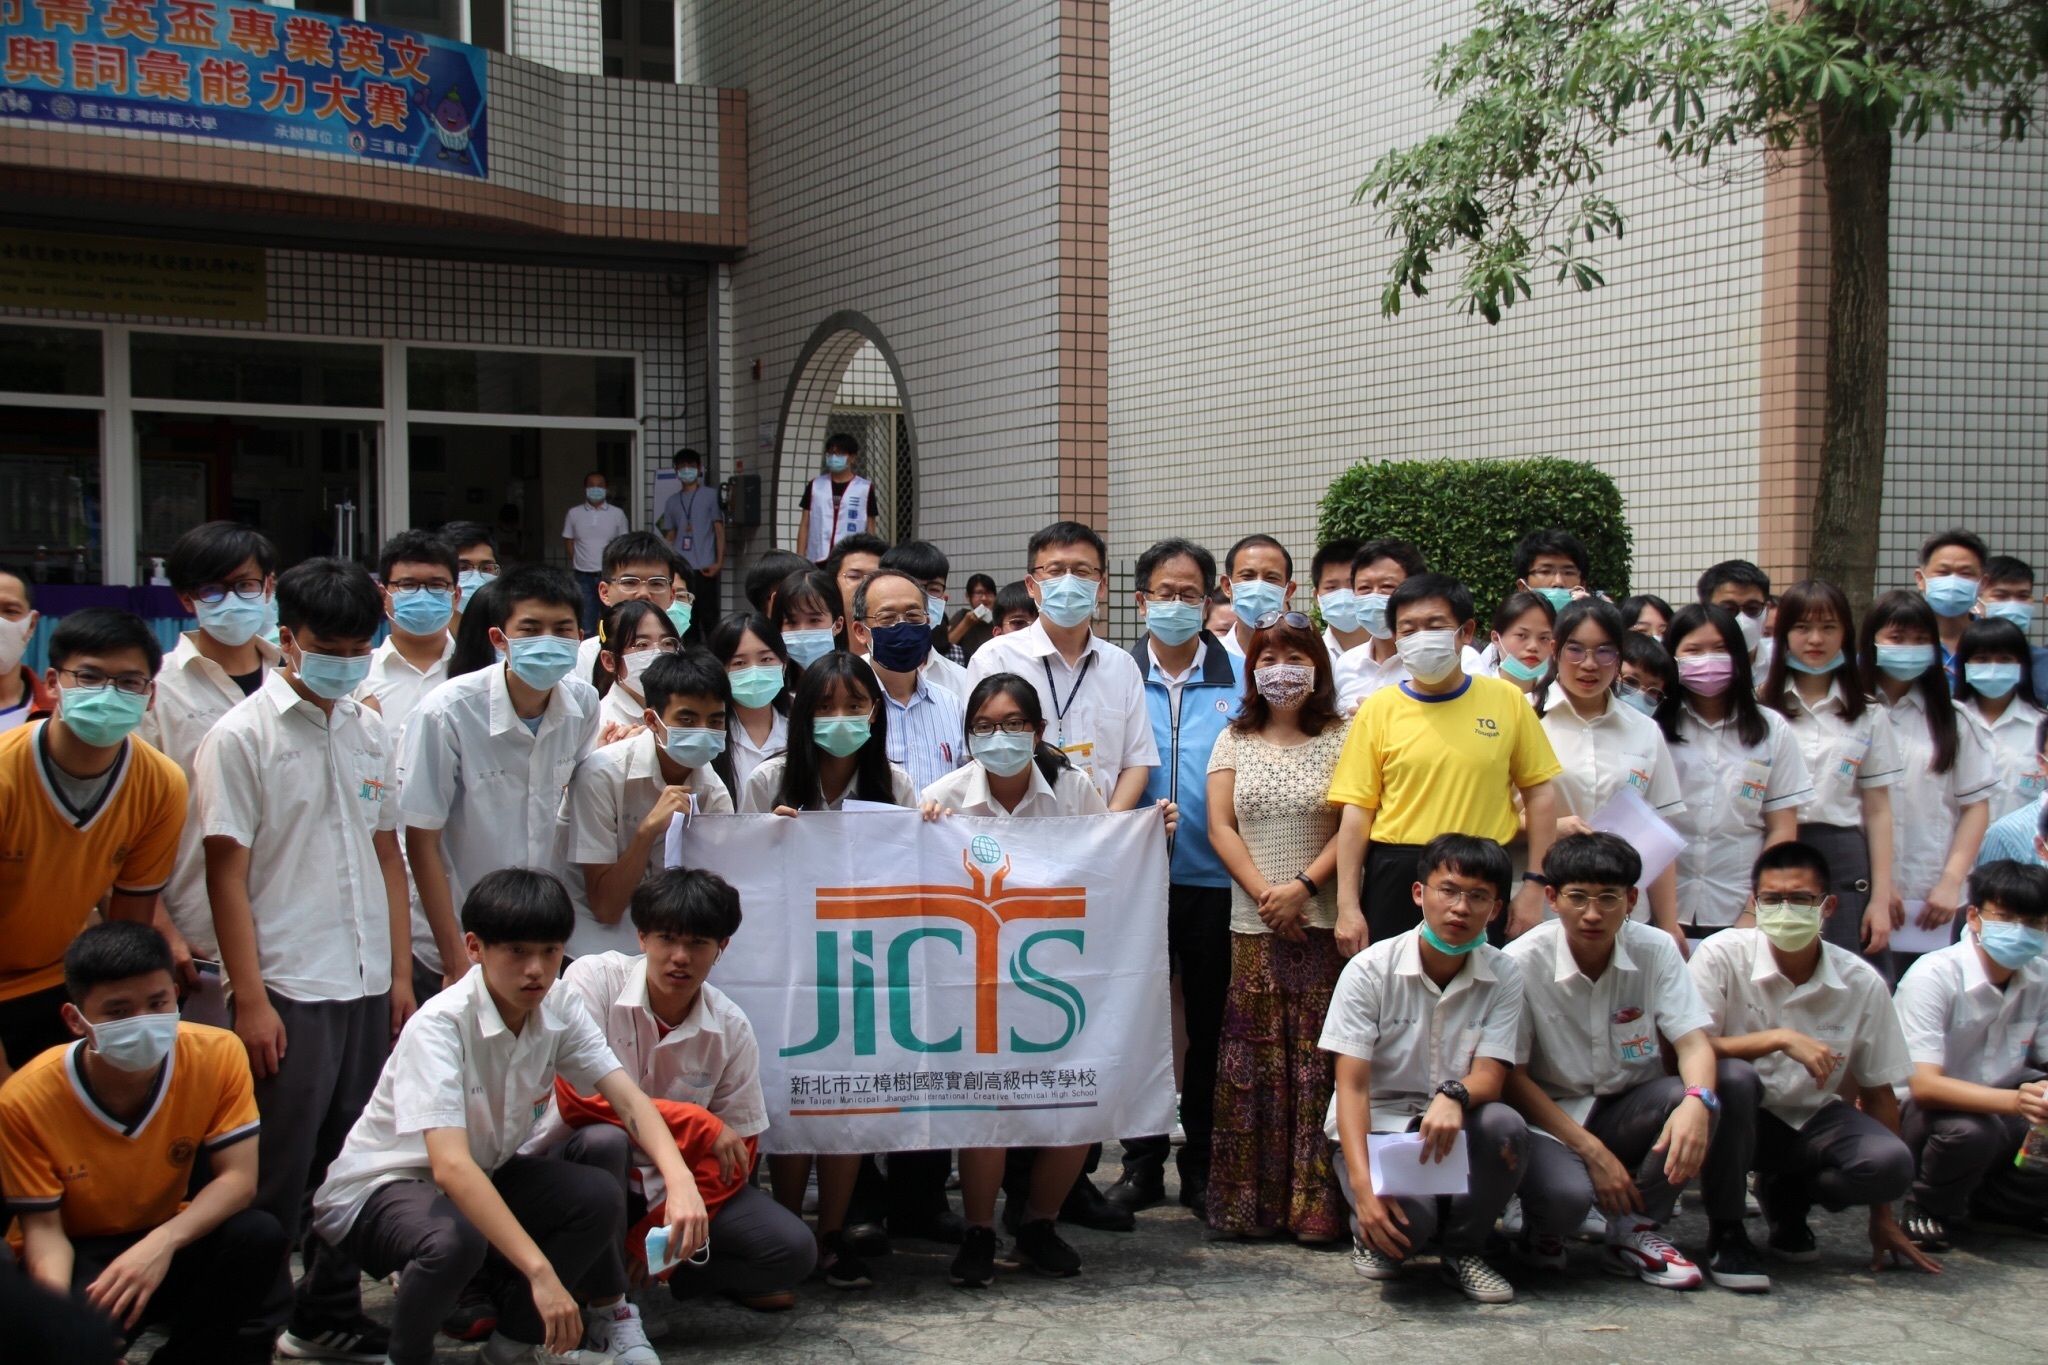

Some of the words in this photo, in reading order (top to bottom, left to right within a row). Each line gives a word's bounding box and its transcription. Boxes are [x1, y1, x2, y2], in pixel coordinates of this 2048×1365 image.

[3, 36, 408, 132] 與詞彙能力大賽
[1476, 718, 1496, 730] TQ
[790, 1067, 1098, 1096] 新北市立樟樹國際實創高級中等學校
[790, 1097, 806, 1106] New
[809, 1096, 836, 1106] Taipei
[840, 1095, 880, 1104] Municipal
[884, 1094, 920, 1104] Jhangshu
[924, 1092, 969, 1101] International
[973, 1091, 1009, 1101] Creative
[1013, 1090, 1048, 1100] Technical
[1051, 1090, 1068, 1100] High
[1071, 1089, 1098, 1098] School
